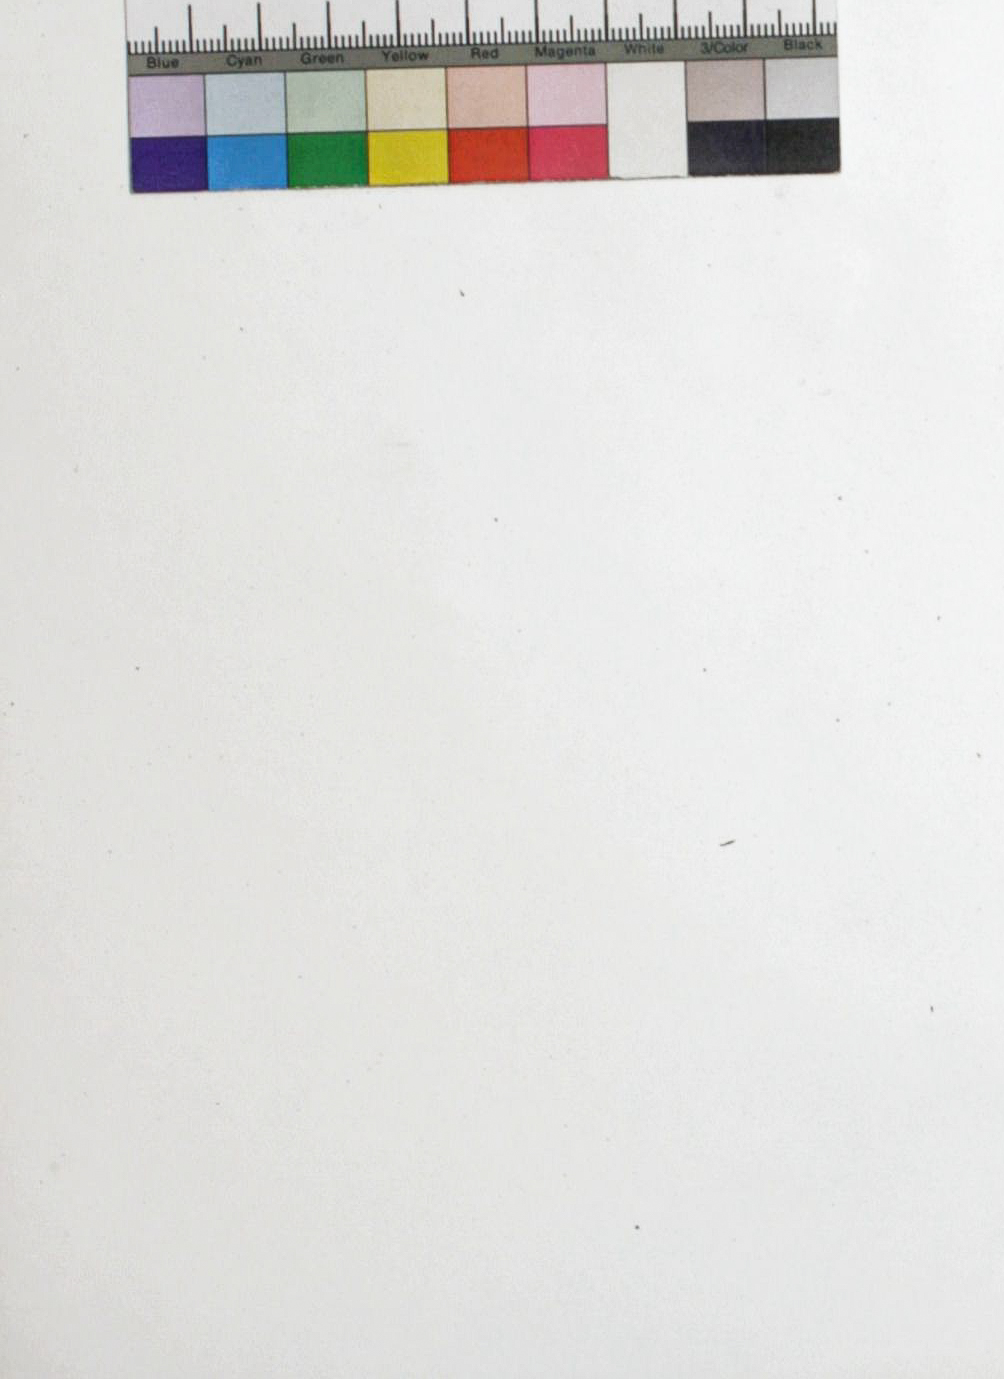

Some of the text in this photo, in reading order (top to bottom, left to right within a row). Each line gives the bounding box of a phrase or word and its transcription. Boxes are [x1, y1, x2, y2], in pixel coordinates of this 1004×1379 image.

[146, 39, 823, 69] Blue Cyan Green Yellow Red Magenta White 3/Color Black
